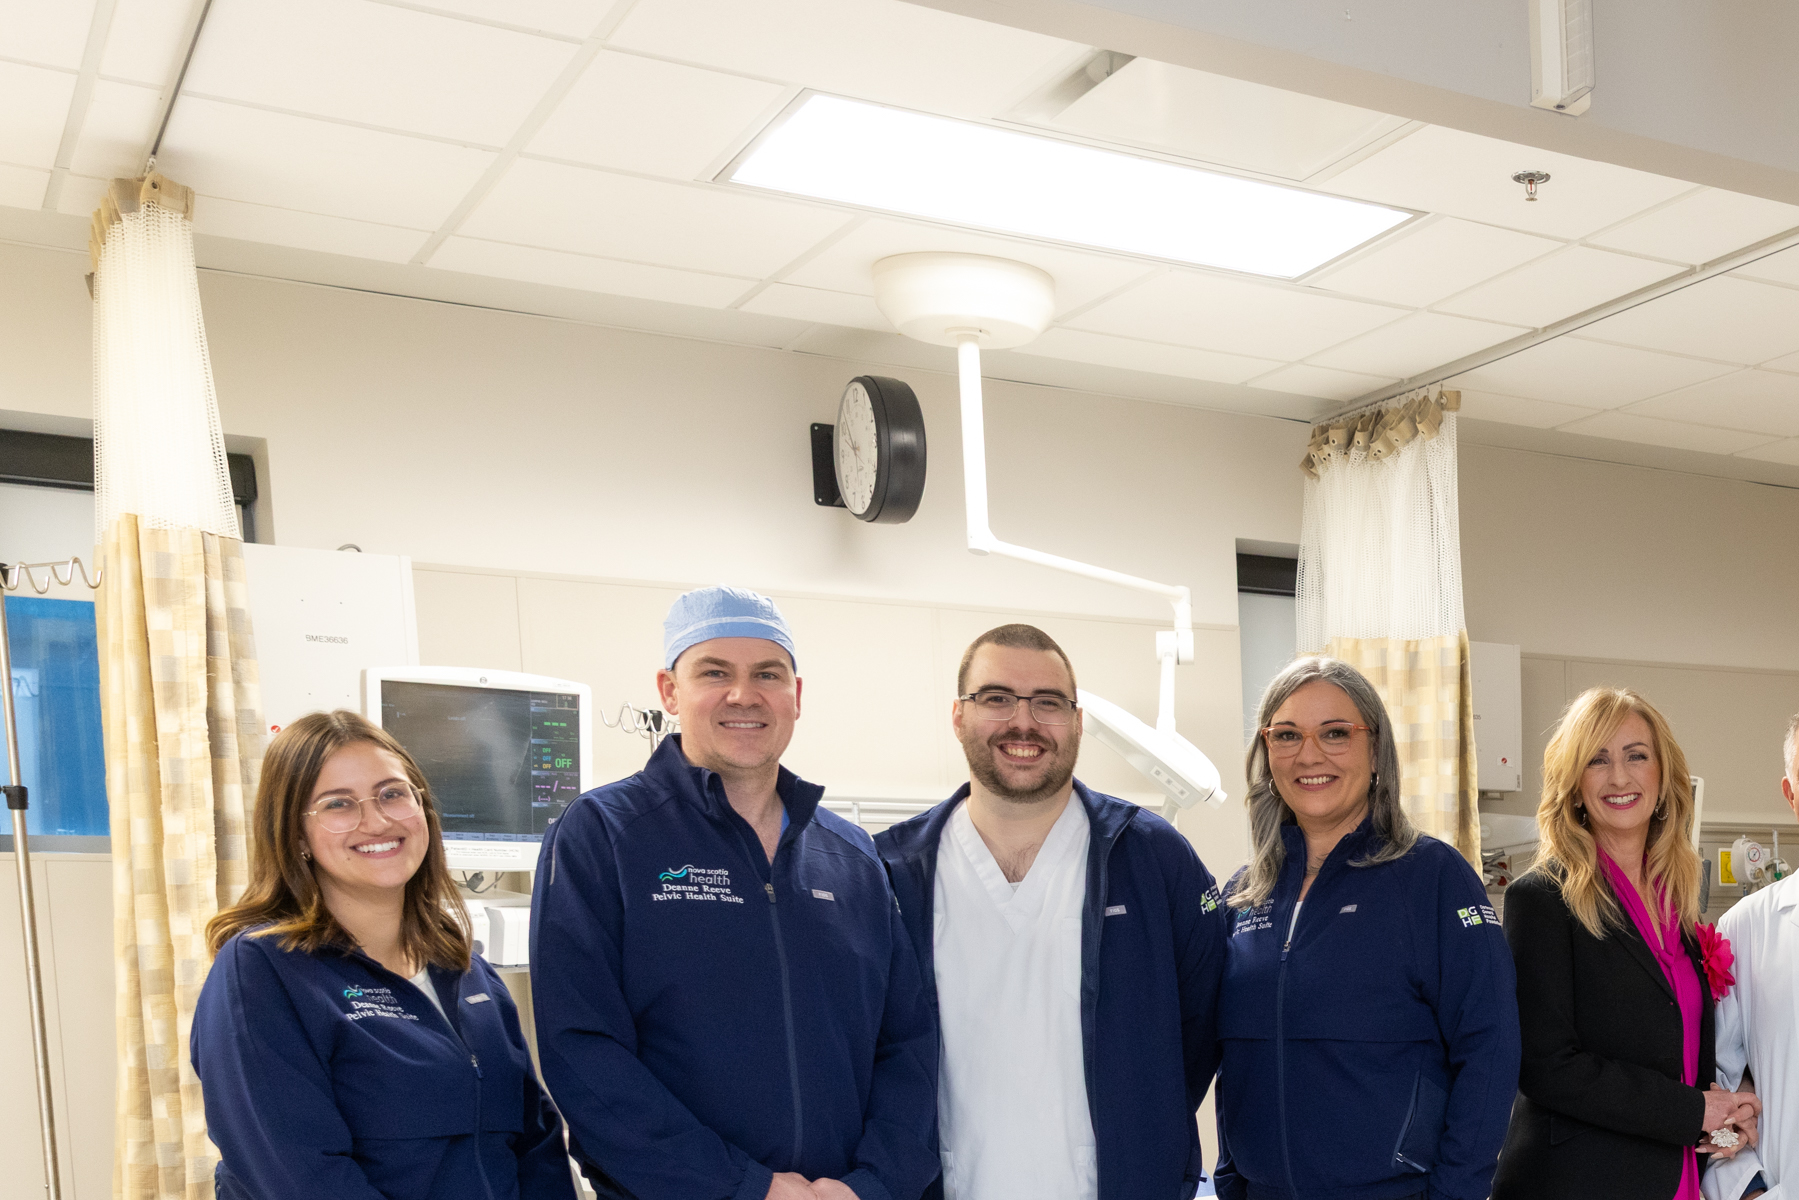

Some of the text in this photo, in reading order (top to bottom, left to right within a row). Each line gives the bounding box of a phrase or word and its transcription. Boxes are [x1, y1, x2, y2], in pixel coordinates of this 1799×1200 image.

[555, 758, 572, 768] OFF
[690, 873, 730, 885] health
[662, 884, 731, 894] Deanne Reeve
[652, 892, 744, 904] Pelvic Health Suite
[345, 1009, 375, 1020] Pelvic
